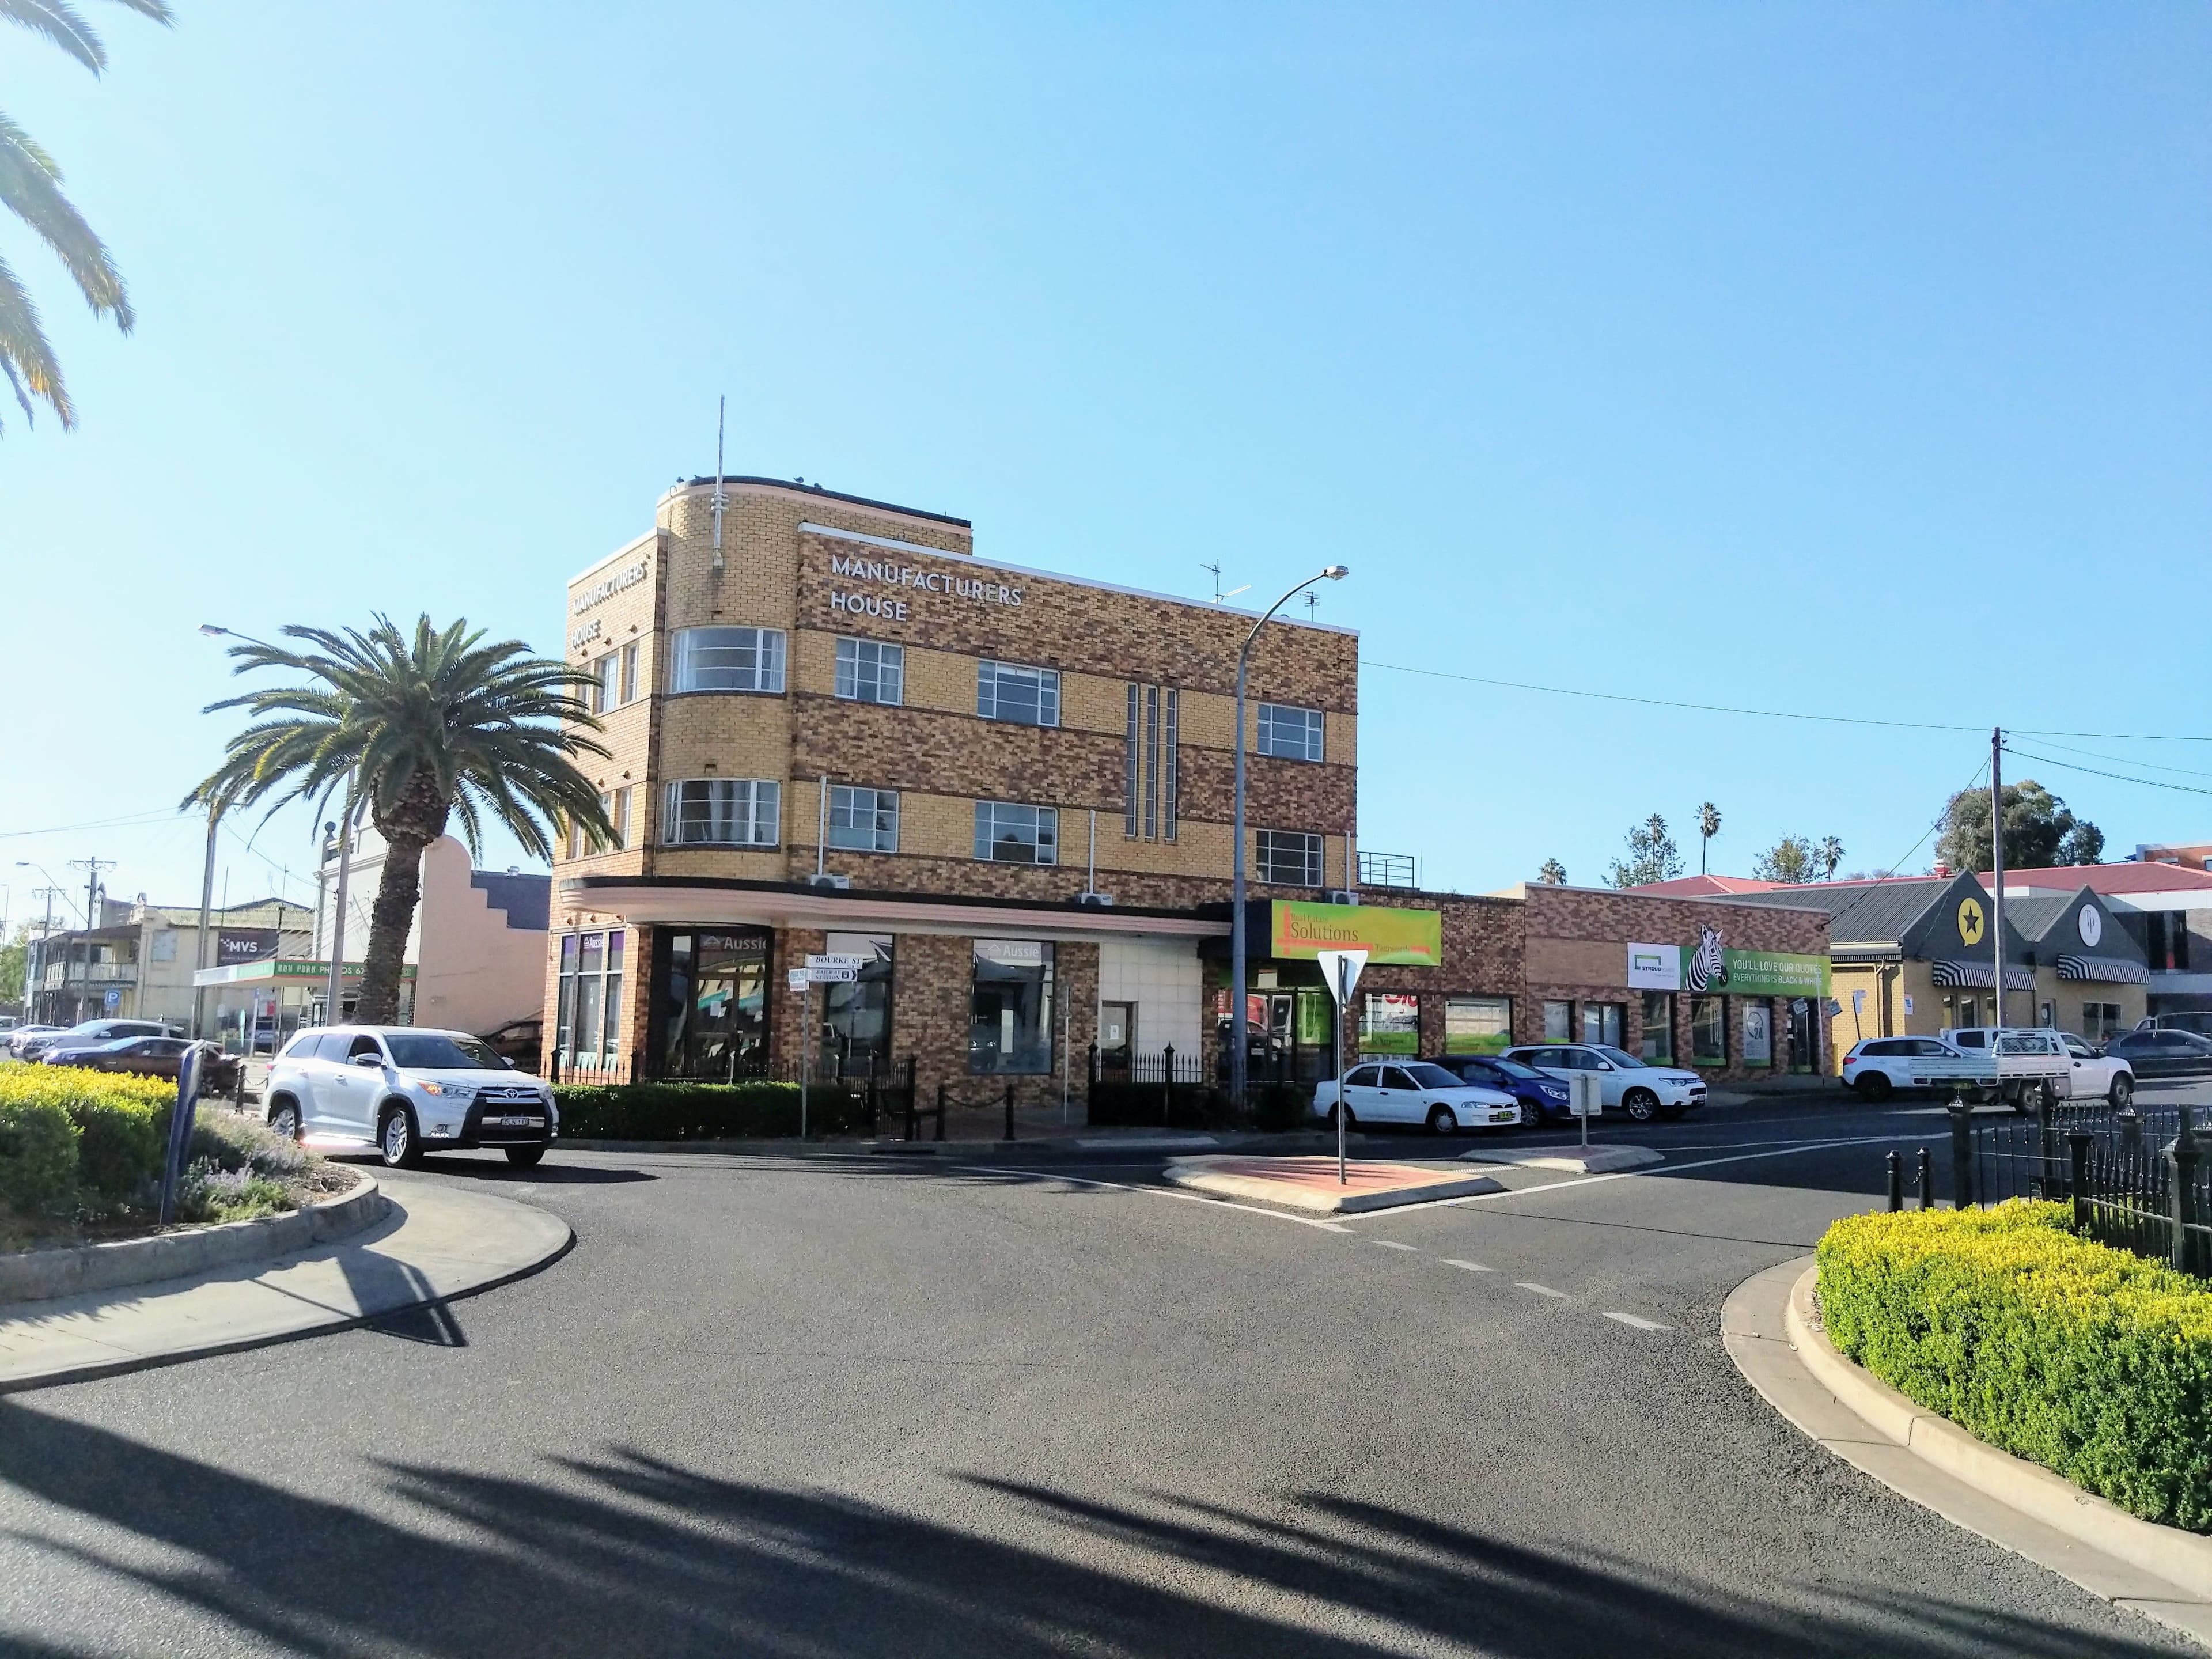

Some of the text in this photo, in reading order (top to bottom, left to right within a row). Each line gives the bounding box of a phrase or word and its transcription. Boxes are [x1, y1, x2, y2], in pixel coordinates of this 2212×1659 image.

[831, 590, 907, 622] HOUSE
[571, 620, 600, 648] HOUSE
[1291, 922, 1358, 942] Solutions
[230, 940, 258, 953] MVS
[589, 935, 604, 948] Aussi
[1003, 944, 1039, 957] Aussie
[320, 966, 353, 975] PHOS
[1733, 959, 1822, 974] YOU'LL LOVE OUR QUOTES
[1733, 972, 1770, 983] EVERYTHING
[1771, 974, 1777, 983] IS
[1778, 975, 1797, 984] BLACK
